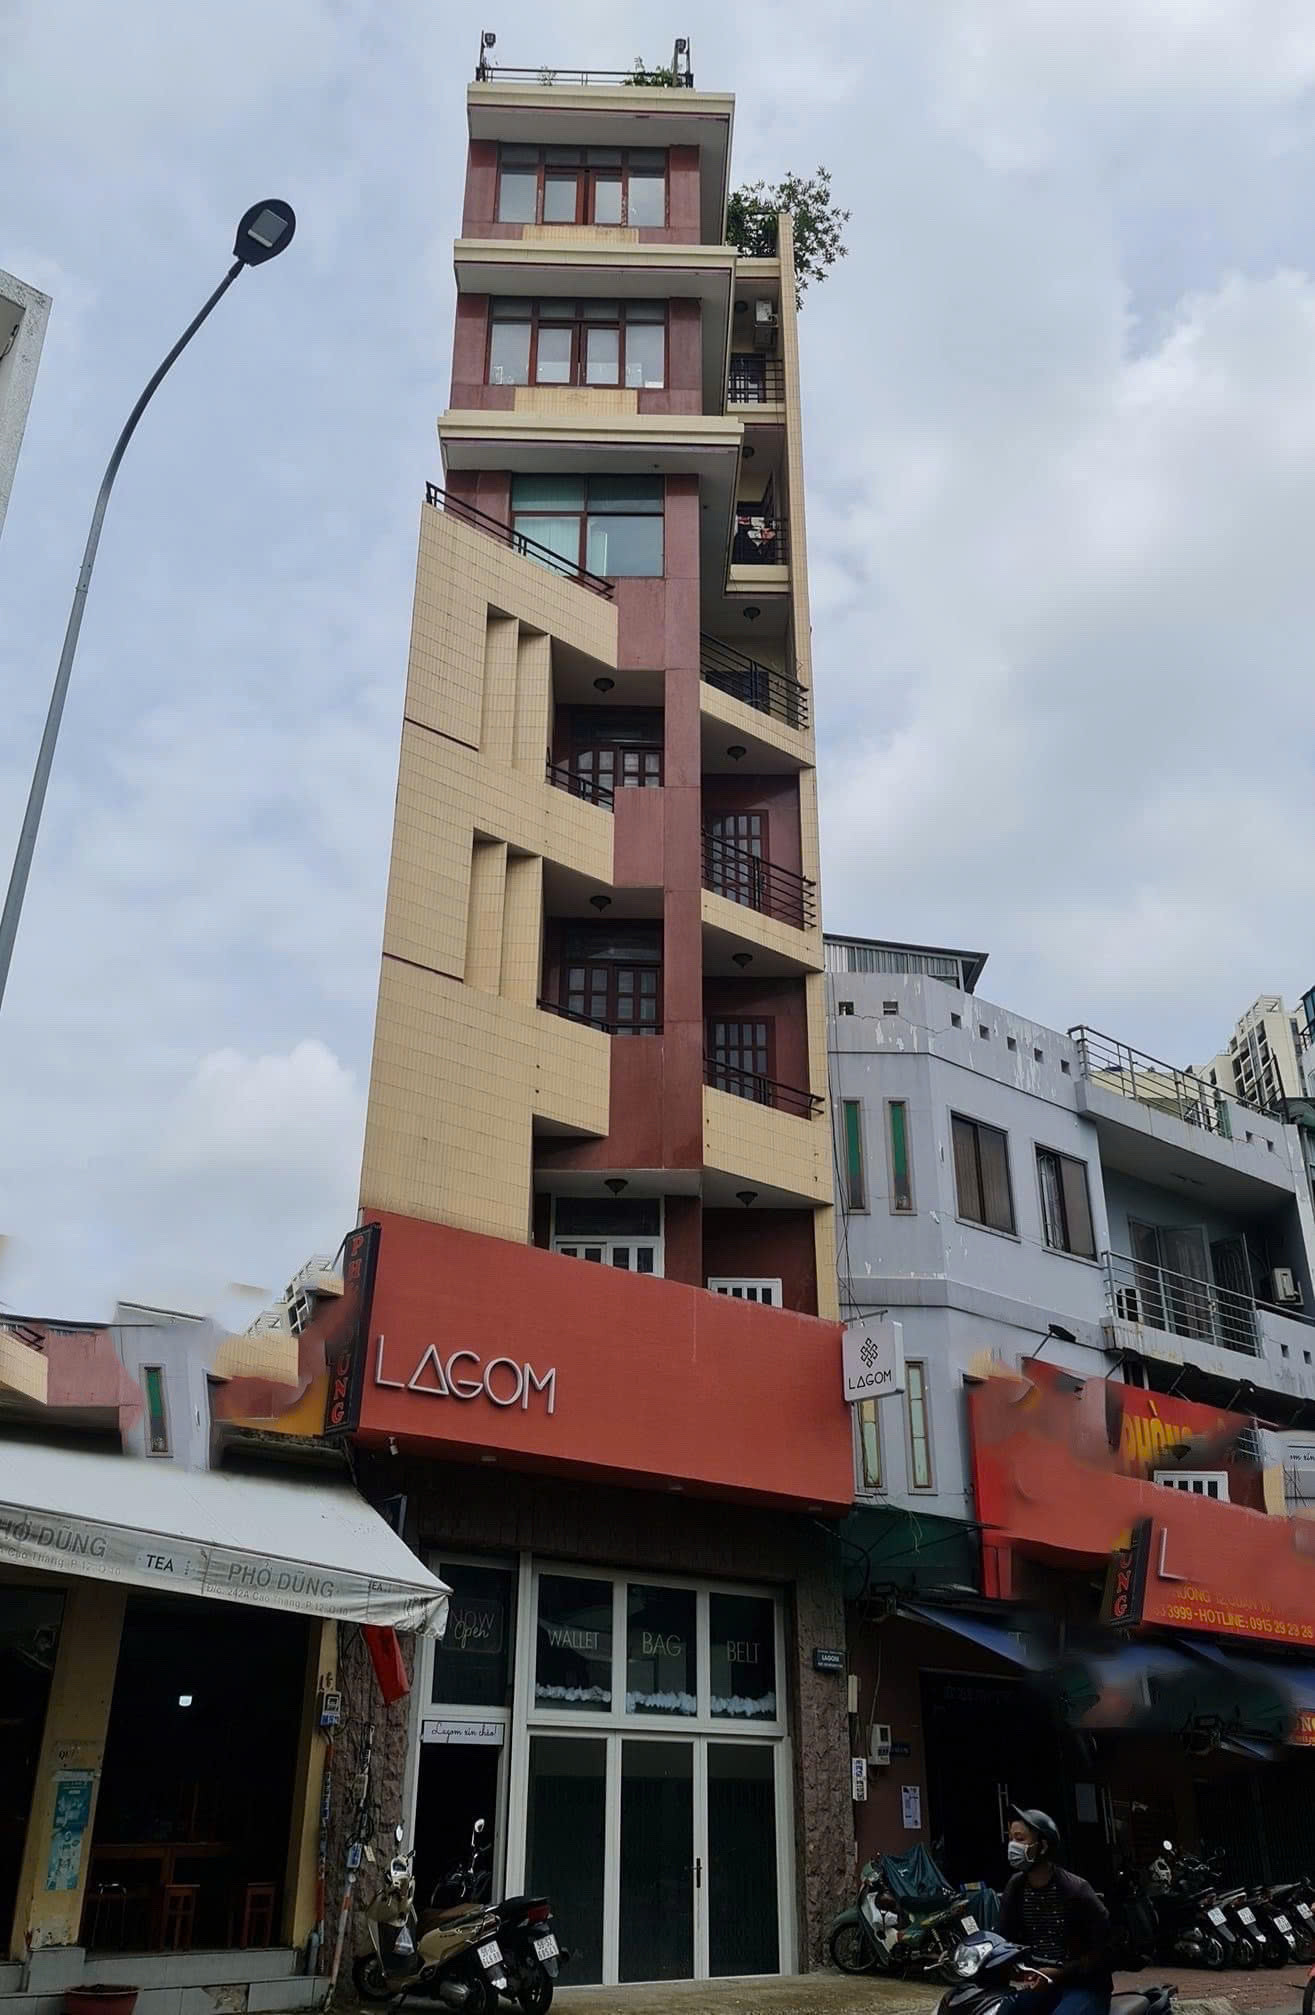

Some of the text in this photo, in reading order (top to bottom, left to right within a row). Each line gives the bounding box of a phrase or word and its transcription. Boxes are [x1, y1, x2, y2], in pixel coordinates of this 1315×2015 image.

[375, 1334, 556, 1414] LAGOM
[848, 1369, 892, 1390] LAGOM
[37, 1524, 107, 1558] DŨNG
[146, 1553, 175, 1573] TEA
[277, 1570, 336, 1598] DŨNG
[550, 1630, 600, 1650] WALLET
[642, 1631, 682, 1657] BAG
[726, 1640, 761, 1664] BELT
